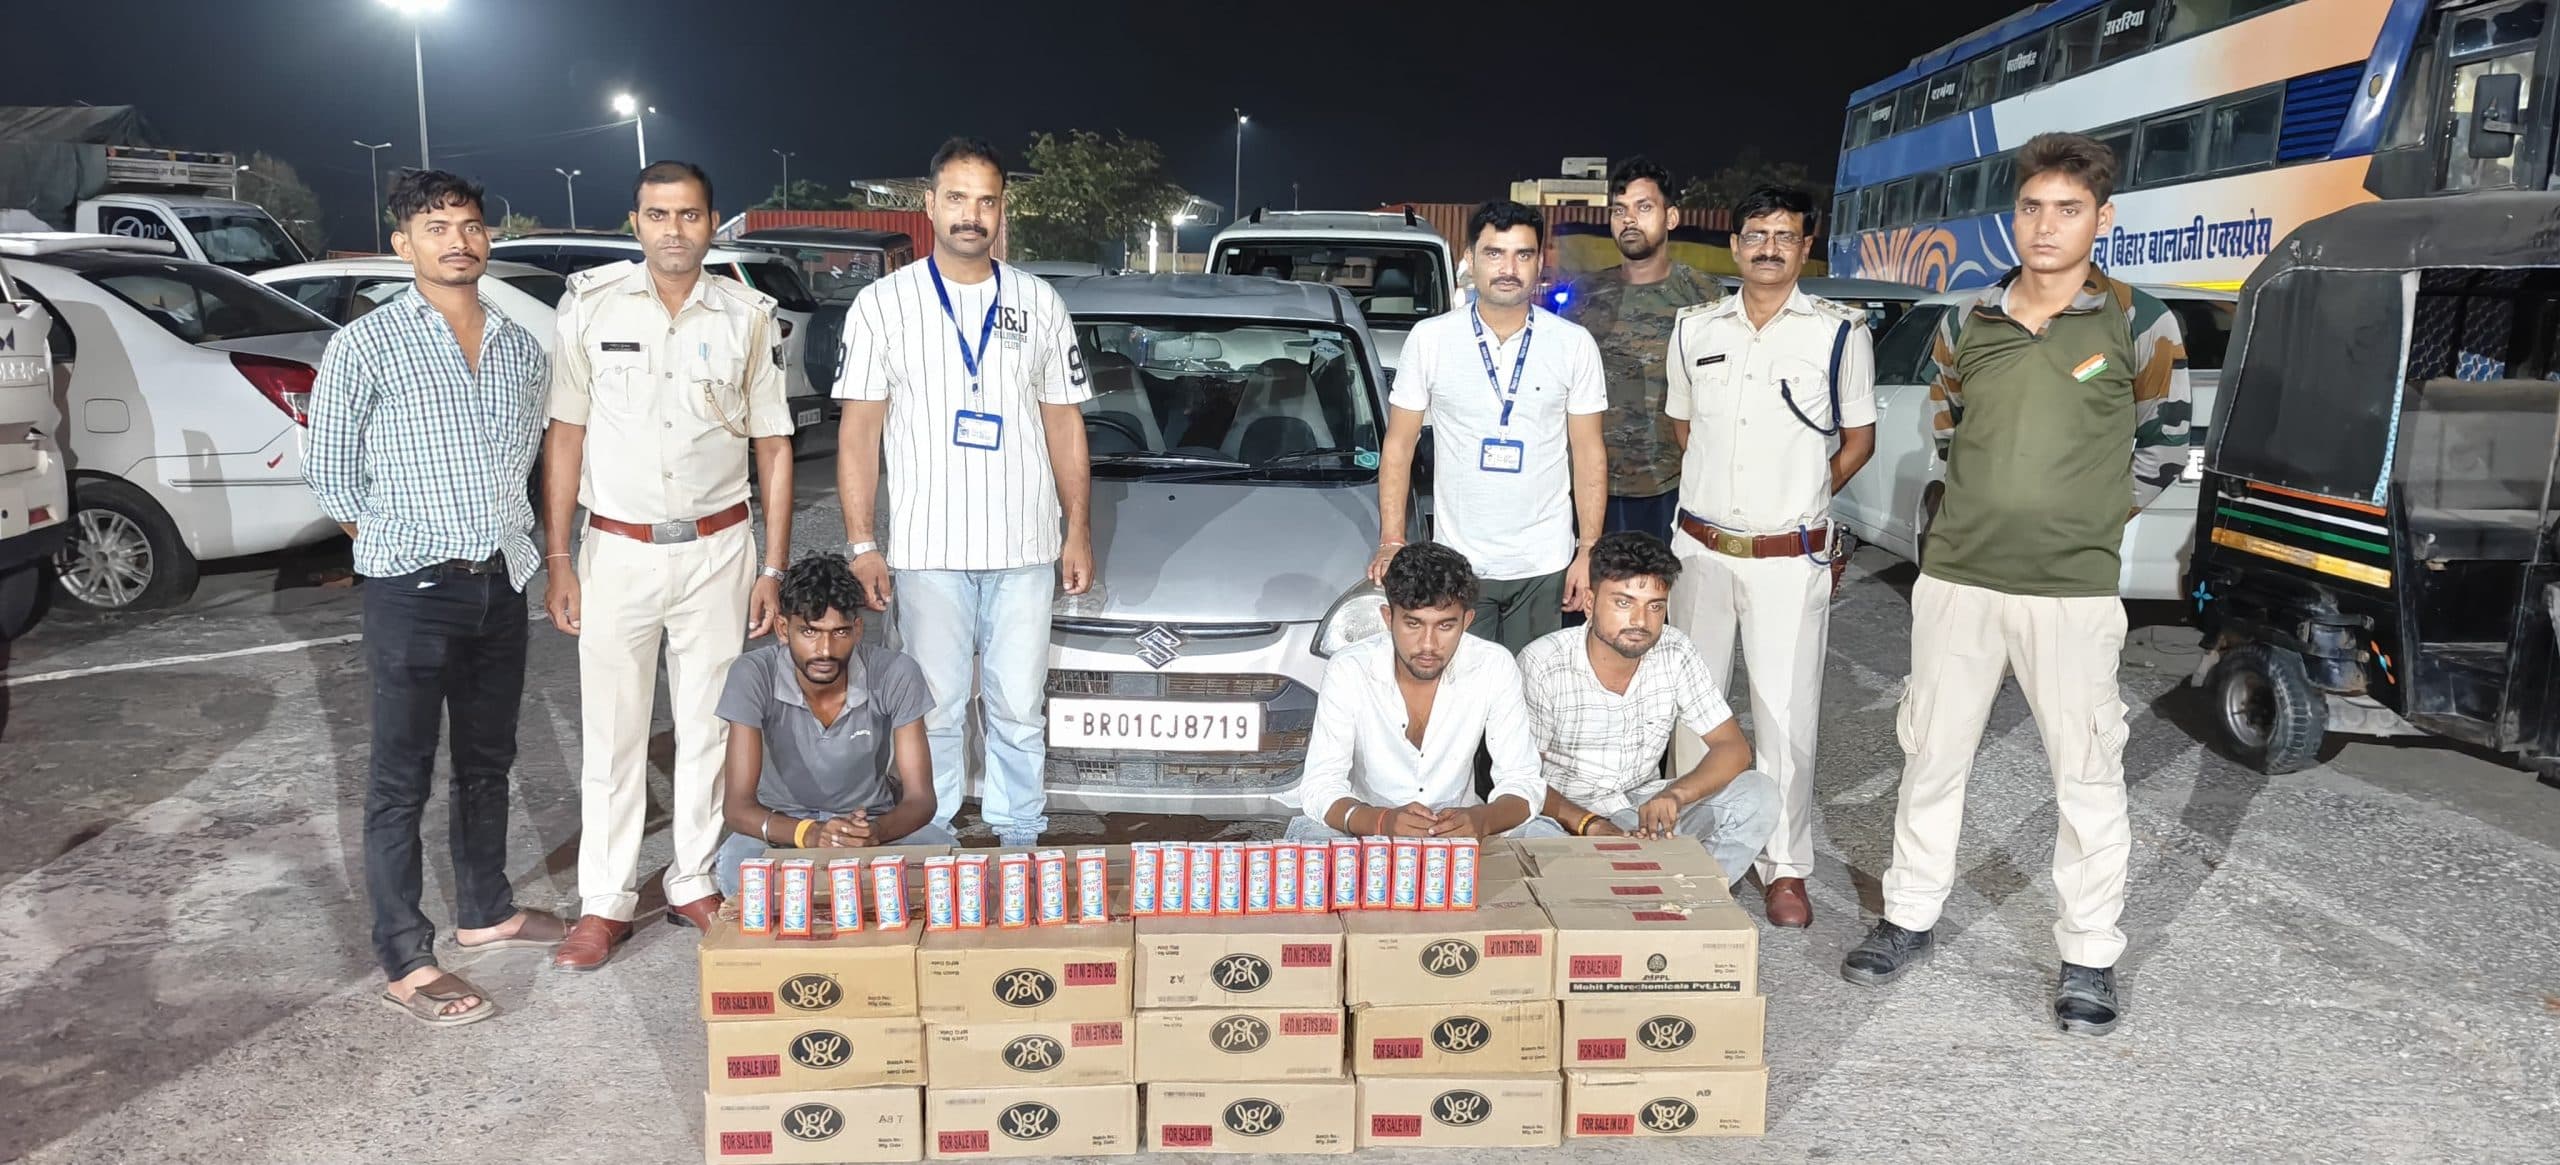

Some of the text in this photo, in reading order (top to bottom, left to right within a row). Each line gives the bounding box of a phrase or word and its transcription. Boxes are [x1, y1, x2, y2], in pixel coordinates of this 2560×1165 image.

[2104, 9, 2145, 37] अररिया
[2111, 226, 2146, 267] बिहार
[2149, 215, 2204, 264] बालाजी
[2207, 207, 2272, 260] एक्सप्रेस
[992, 305, 1028, 334] J&J
[1068, 344, 1086, 386] 9
[1083, 712, 1248, 739] BR01CJ8719
[1301, 947, 1317, 963] SALE
[1509, 940, 1524, 955] SALE
[1087, 963, 1103, 978] SALE
[1587, 960, 1601, 975] SALE
[732, 996, 748, 1010] SALE
[1093, 1024, 1109, 1040] SALE
[1303, 1017, 1319, 1032] SALE
[1386, 1044, 1402, 1058] SALE
[1593, 1044, 1608, 1058] SALE
[741, 1060, 758, 1076] SALE
[1387, 1118, 1402, 1132] SALE
[1594, 1118, 1609, 1131] SALE
[737, 1134, 753, 1149] SALE
[954, 1134, 970, 1149] SALE
[1179, 1127, 1194, 1141] SALE
